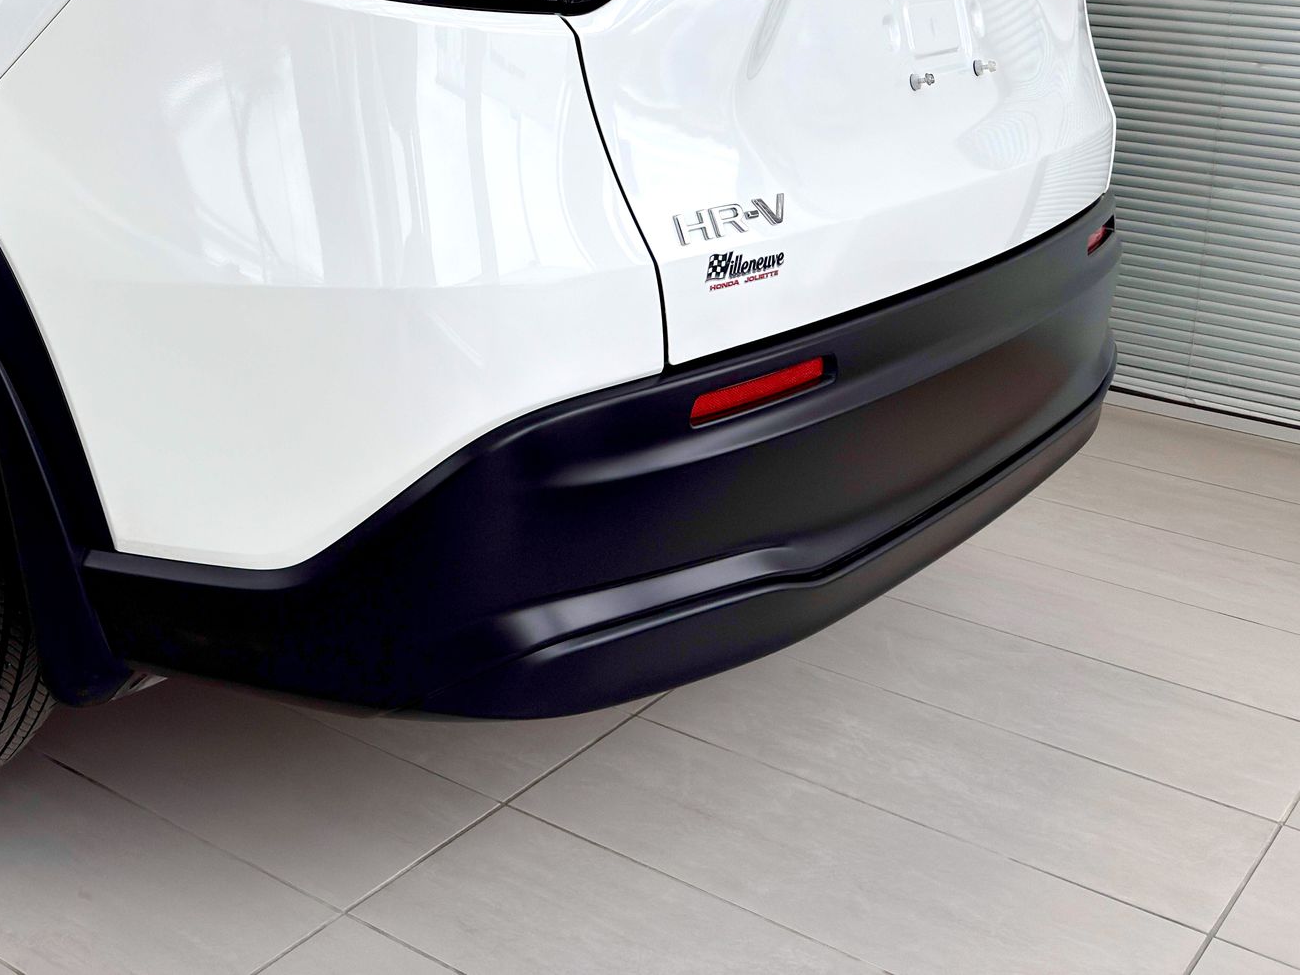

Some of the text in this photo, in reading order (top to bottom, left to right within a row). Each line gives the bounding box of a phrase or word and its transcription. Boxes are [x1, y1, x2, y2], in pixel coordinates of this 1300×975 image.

[672, 192, 785, 247] HR-V
[704, 250, 785, 282] Villeneuve
[709, 270, 779, 292] HONDA JOLIETTE
